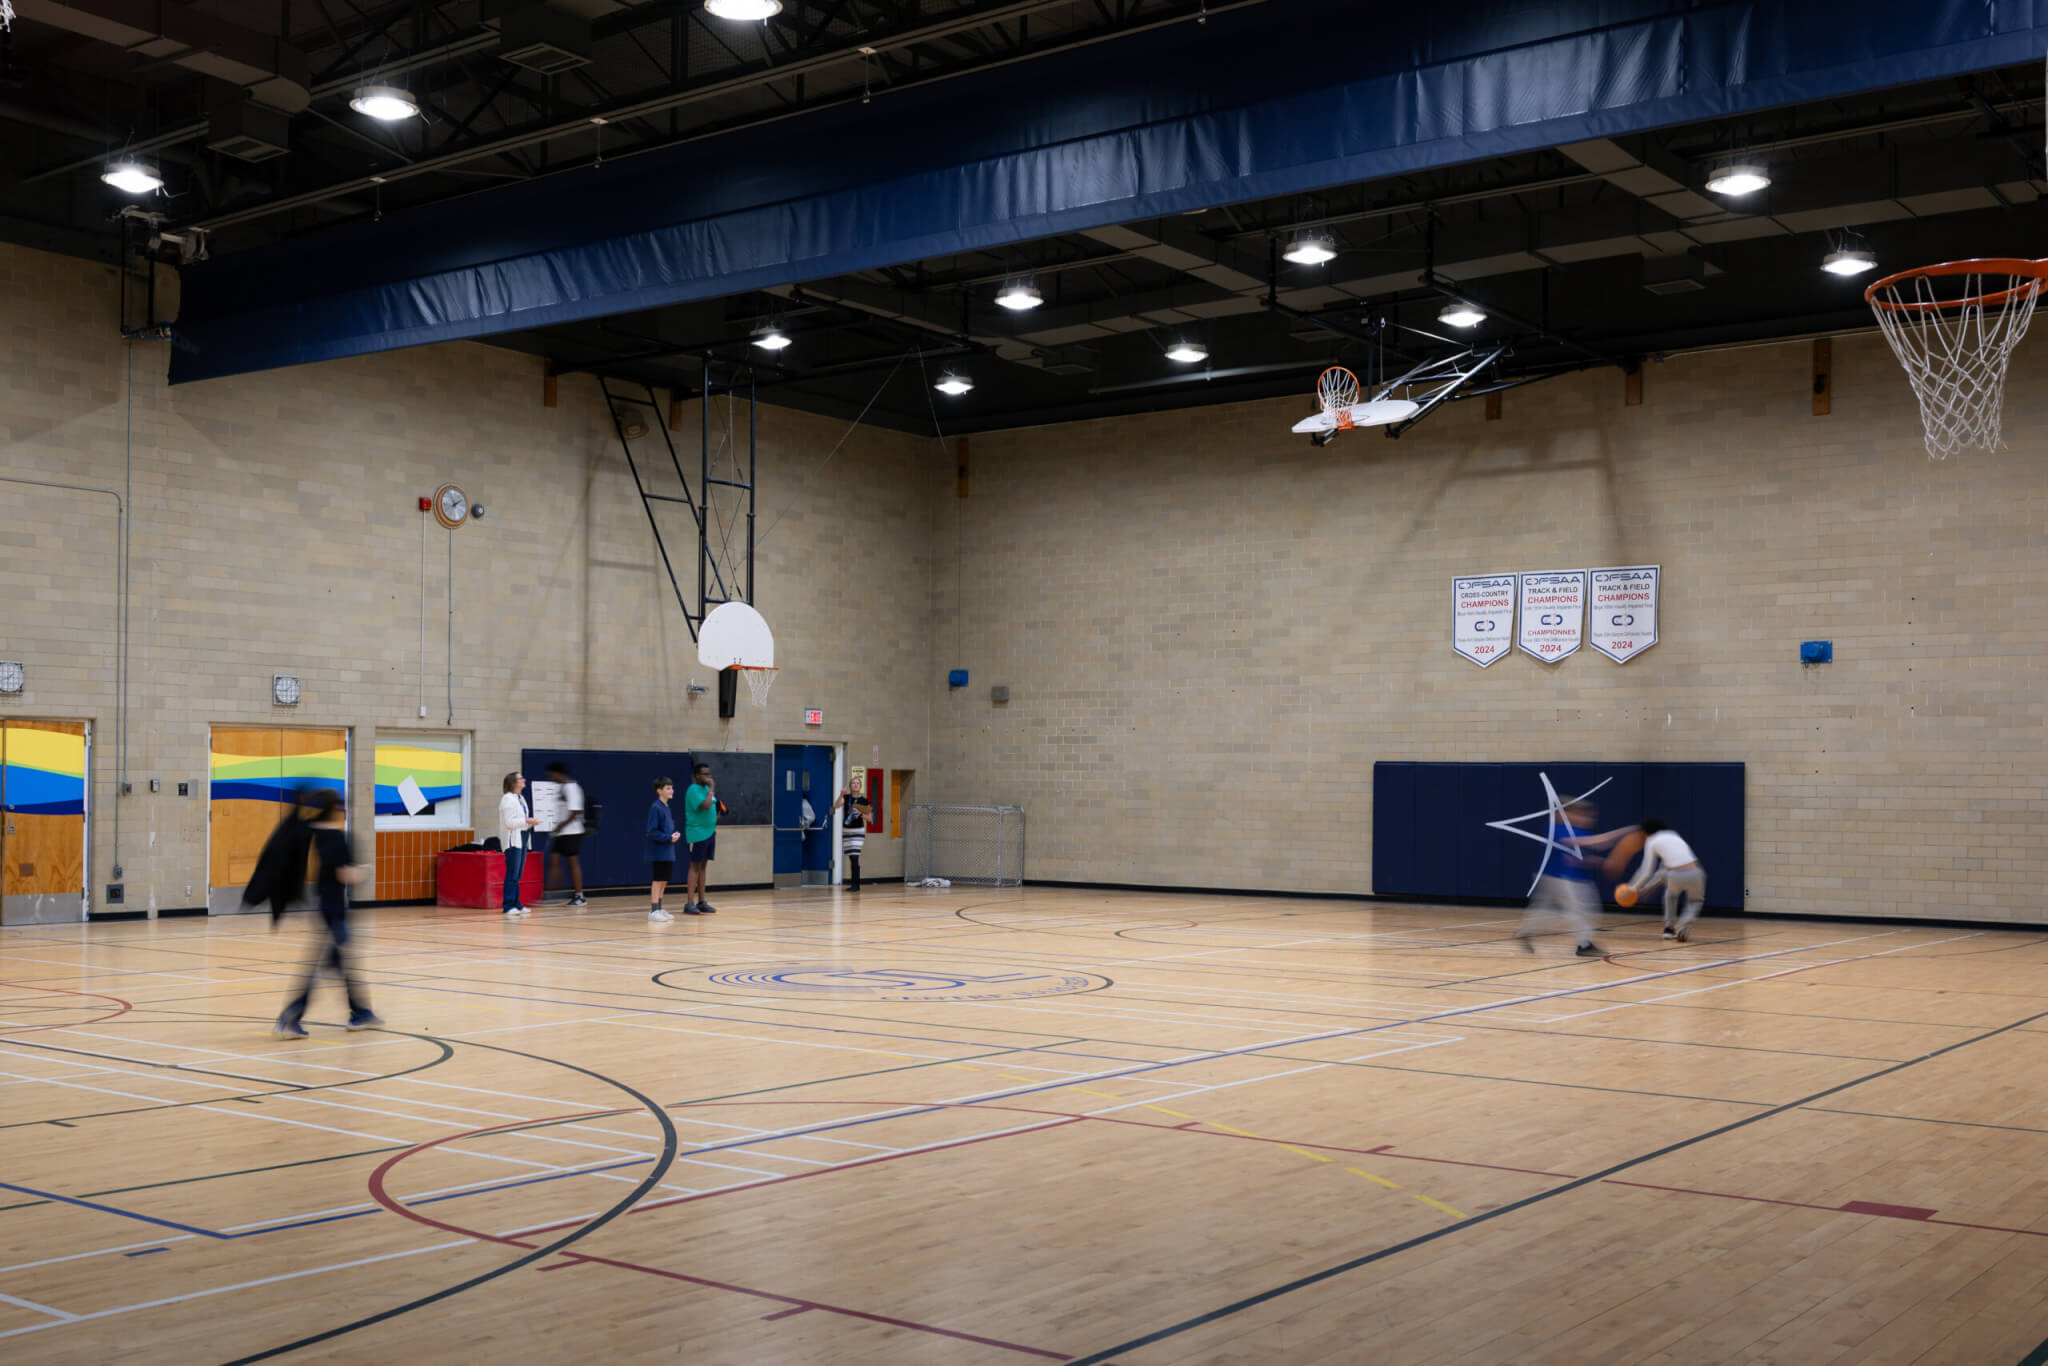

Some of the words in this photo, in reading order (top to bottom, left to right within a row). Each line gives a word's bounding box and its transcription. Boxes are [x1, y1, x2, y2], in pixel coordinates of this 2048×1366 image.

[1598, 584, 1622, 592] TRACK
[1528, 595, 1579, 604] CHAMPIONS
[1597, 592, 1650, 602] CHAMPIONS
[1461, 599, 1509, 609] CHAMPIONS
[1539, 644, 1562, 653] 2024
[1611, 640, 1633, 649] 2024
[1474, 645, 1495, 654] 2024
